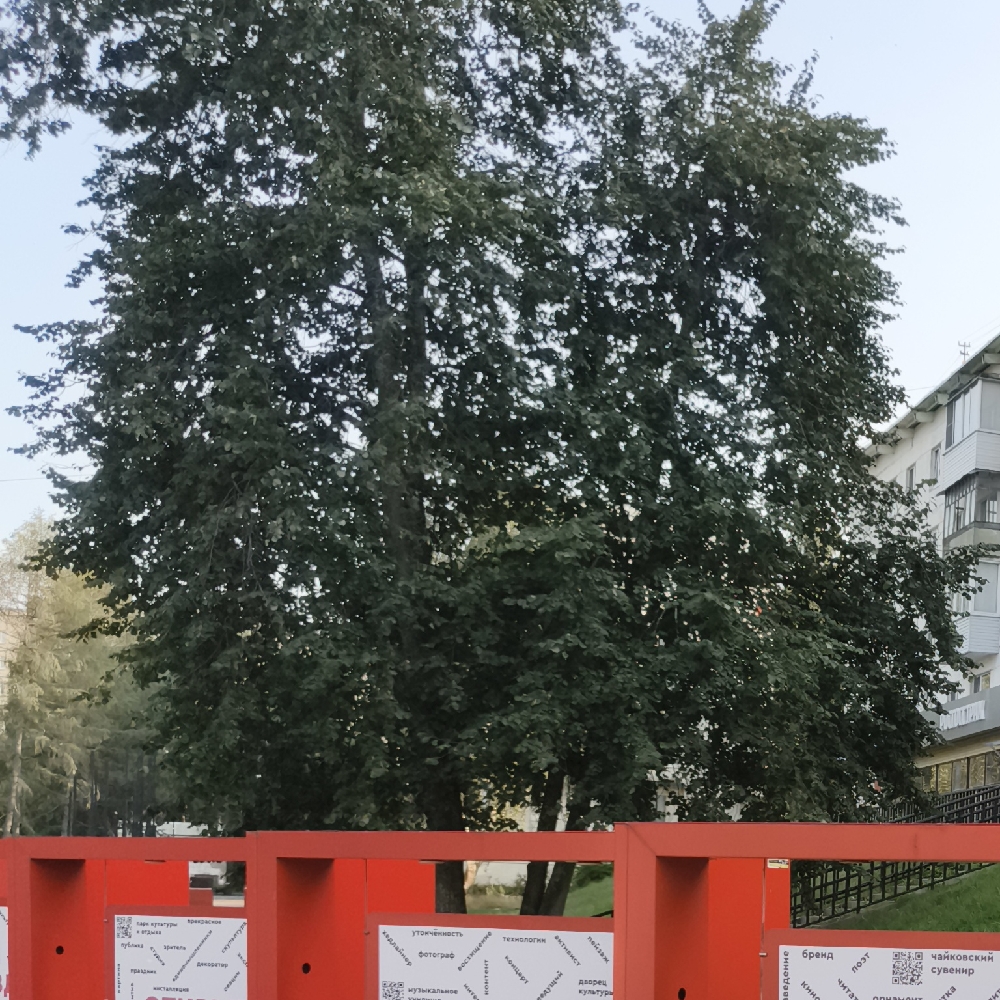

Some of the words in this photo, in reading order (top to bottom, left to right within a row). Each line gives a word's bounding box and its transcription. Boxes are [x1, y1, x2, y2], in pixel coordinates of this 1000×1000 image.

[418, 951, 454, 959] фотограф
[802, 949, 834, 960] бренд
[931, 951, 994, 962] чайковский
[852, 952, 870, 973] поэт
[504, 956, 529, 984] концерт
[931, 967, 974, 977] сувенир
[578, 979, 607, 987] дворец
